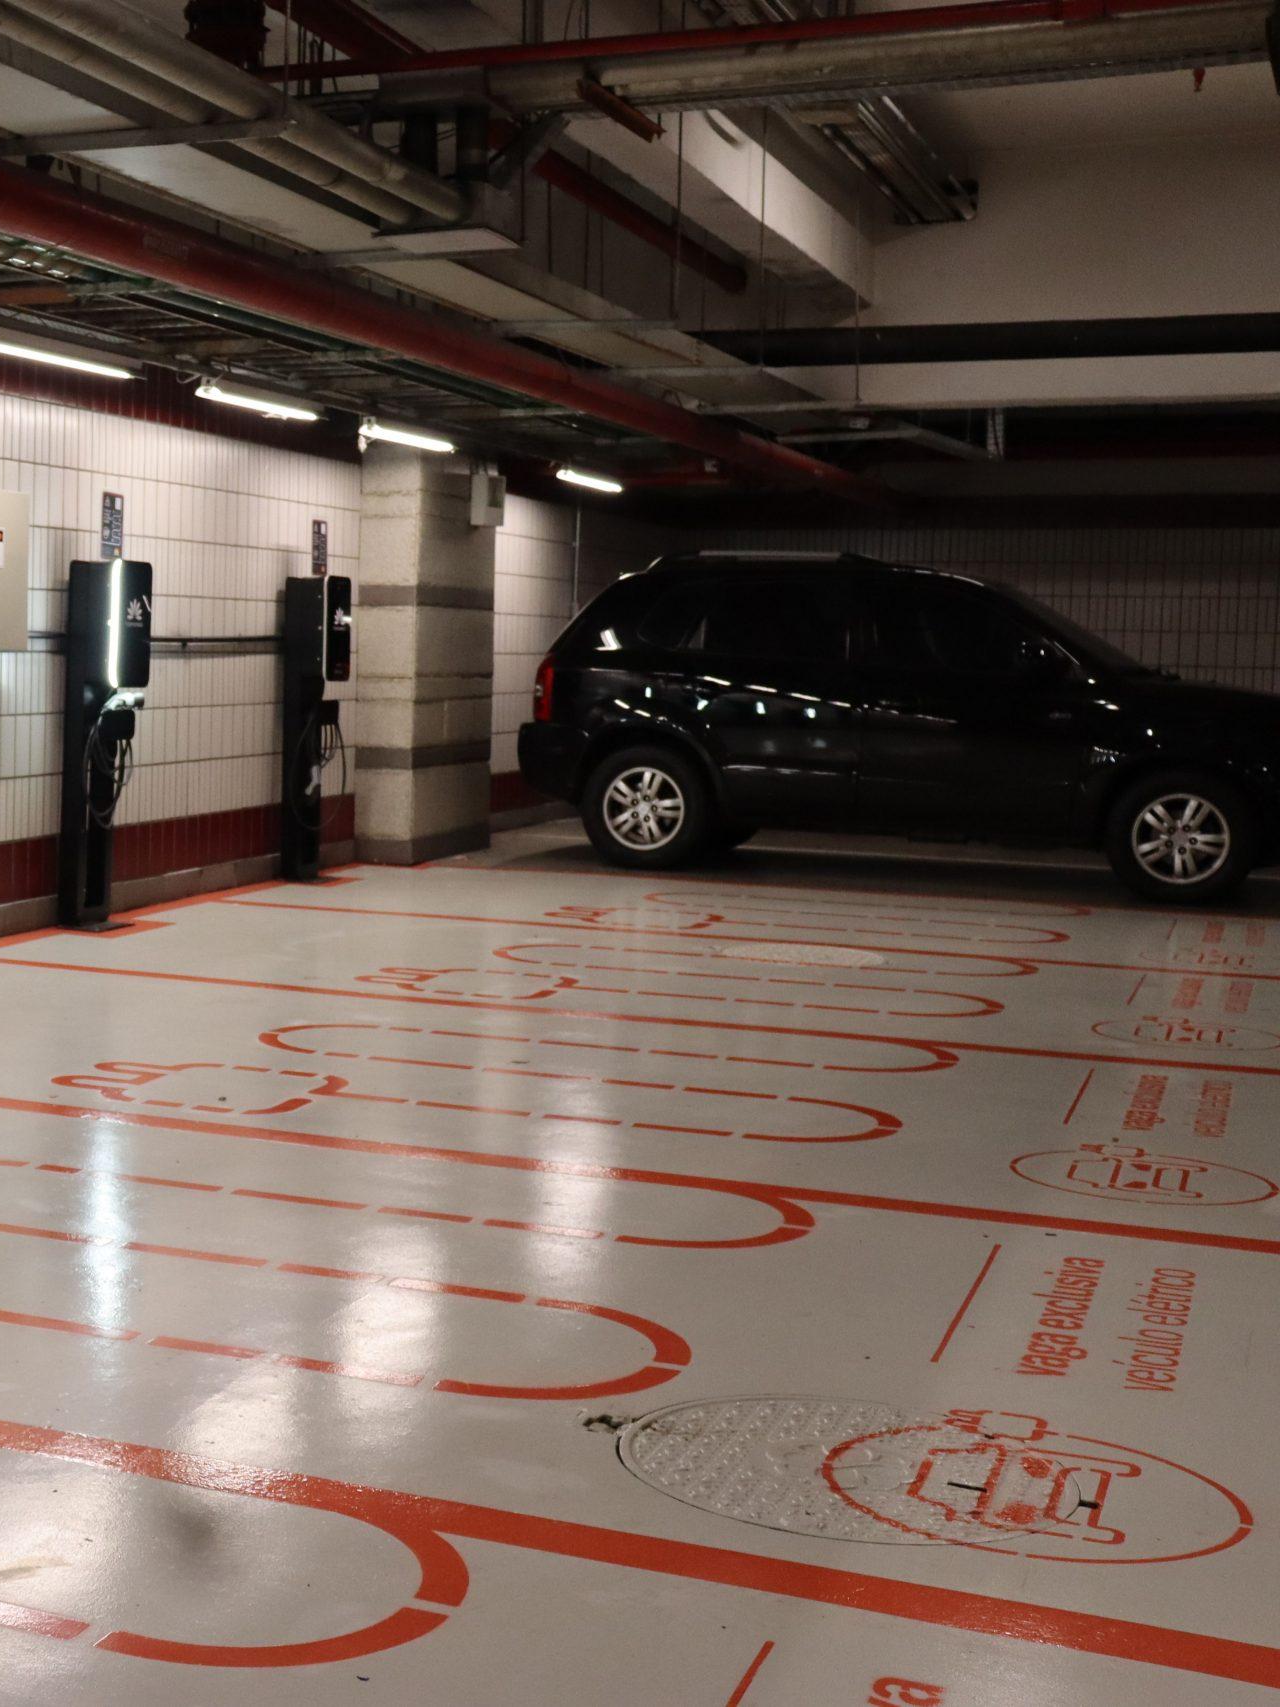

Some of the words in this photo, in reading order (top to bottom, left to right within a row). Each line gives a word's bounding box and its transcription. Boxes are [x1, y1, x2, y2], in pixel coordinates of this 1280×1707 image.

[1032, 1256, 1105, 1331] exclusiva
[1126, 1267, 1196, 1327] elétrico
[1016, 1331, 1088, 1376] vaga
[1111, 1328, 1184, 1392] veículo
